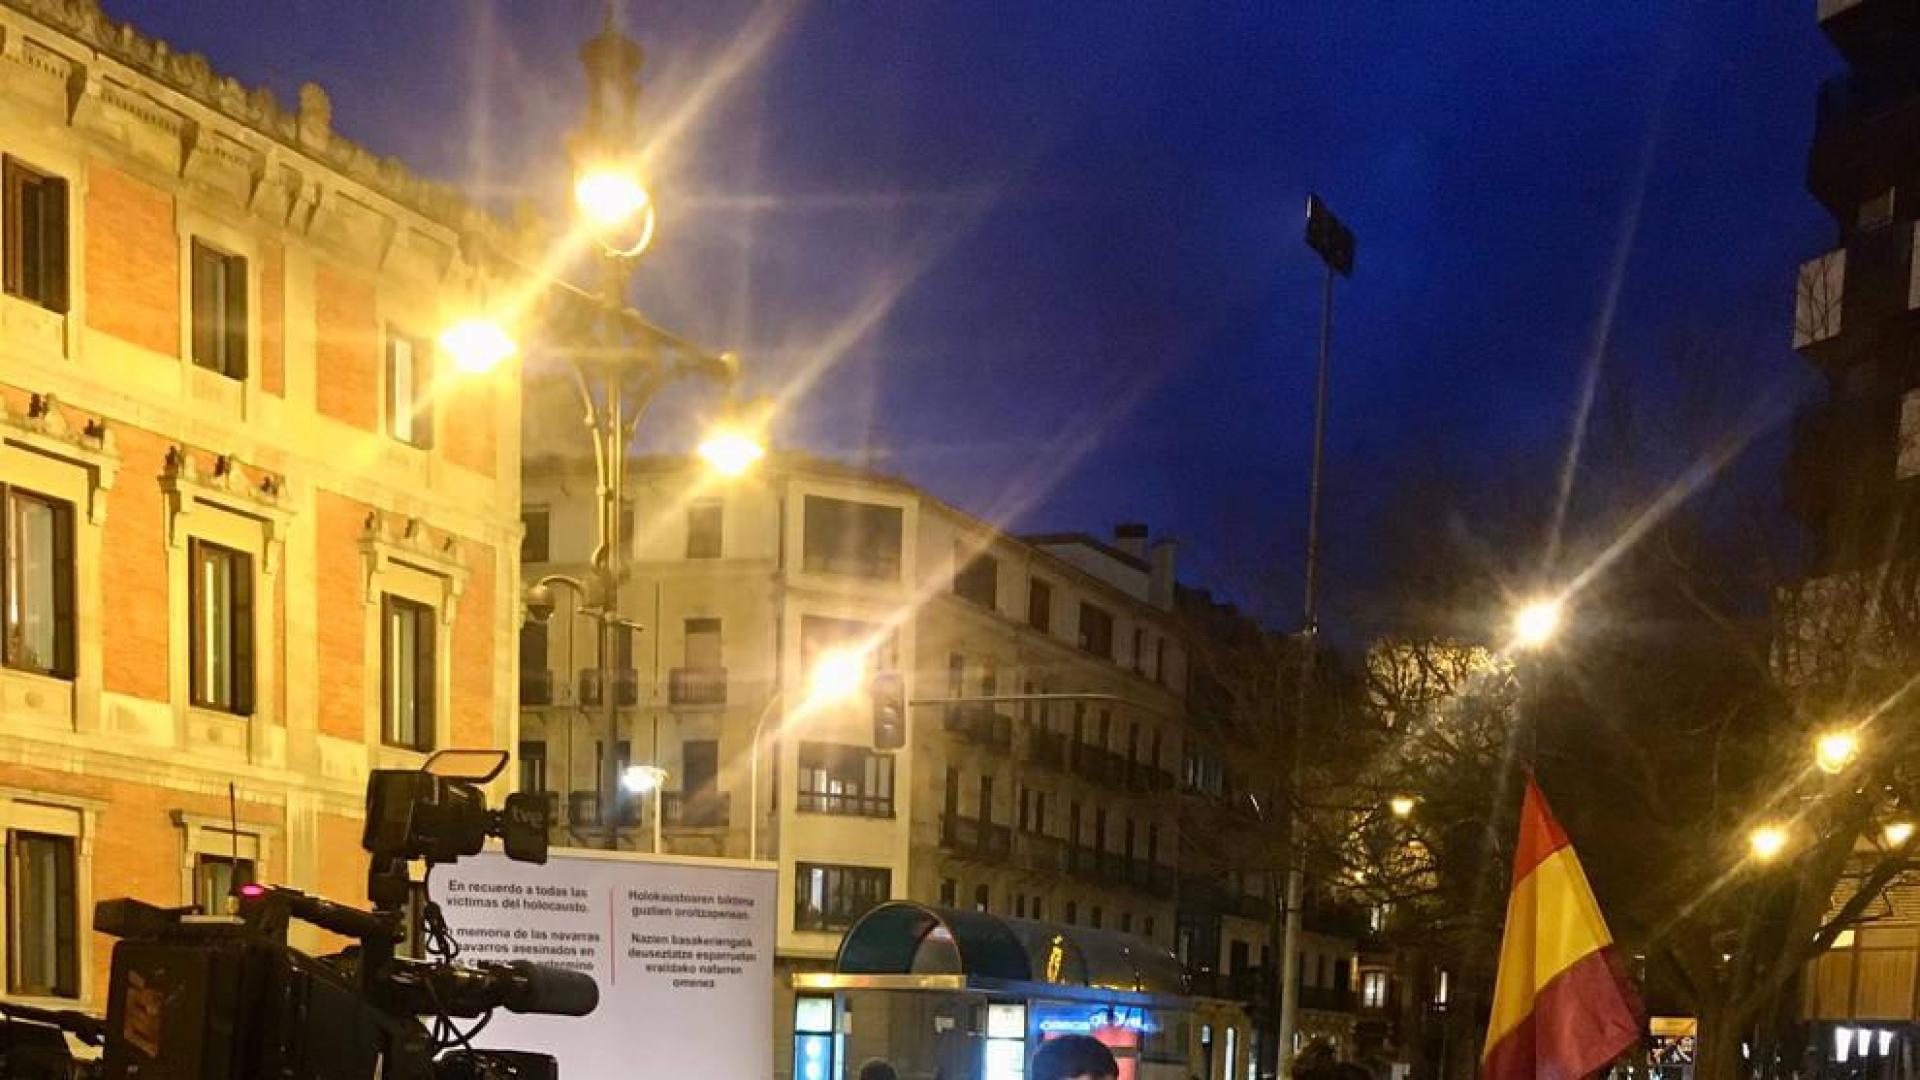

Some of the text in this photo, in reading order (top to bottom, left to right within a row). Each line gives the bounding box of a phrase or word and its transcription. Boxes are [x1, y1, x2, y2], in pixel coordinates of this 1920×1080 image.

[448, 879, 588, 898] En recuerdo a todas las
[628, 890, 715, 904] Holokaustoaren
[502, 898, 520, 909] del
[631, 906, 672, 918] guztien
[457, 928, 511, 938] memoria
[513, 929, 528, 939] de
[531, 930, 548, 940] las
[550, 931, 600, 942] navarras
[631, 932, 669, 944] Nazien
[512, 945, 577, 956] asesinados
[579, 946, 595, 957] en
